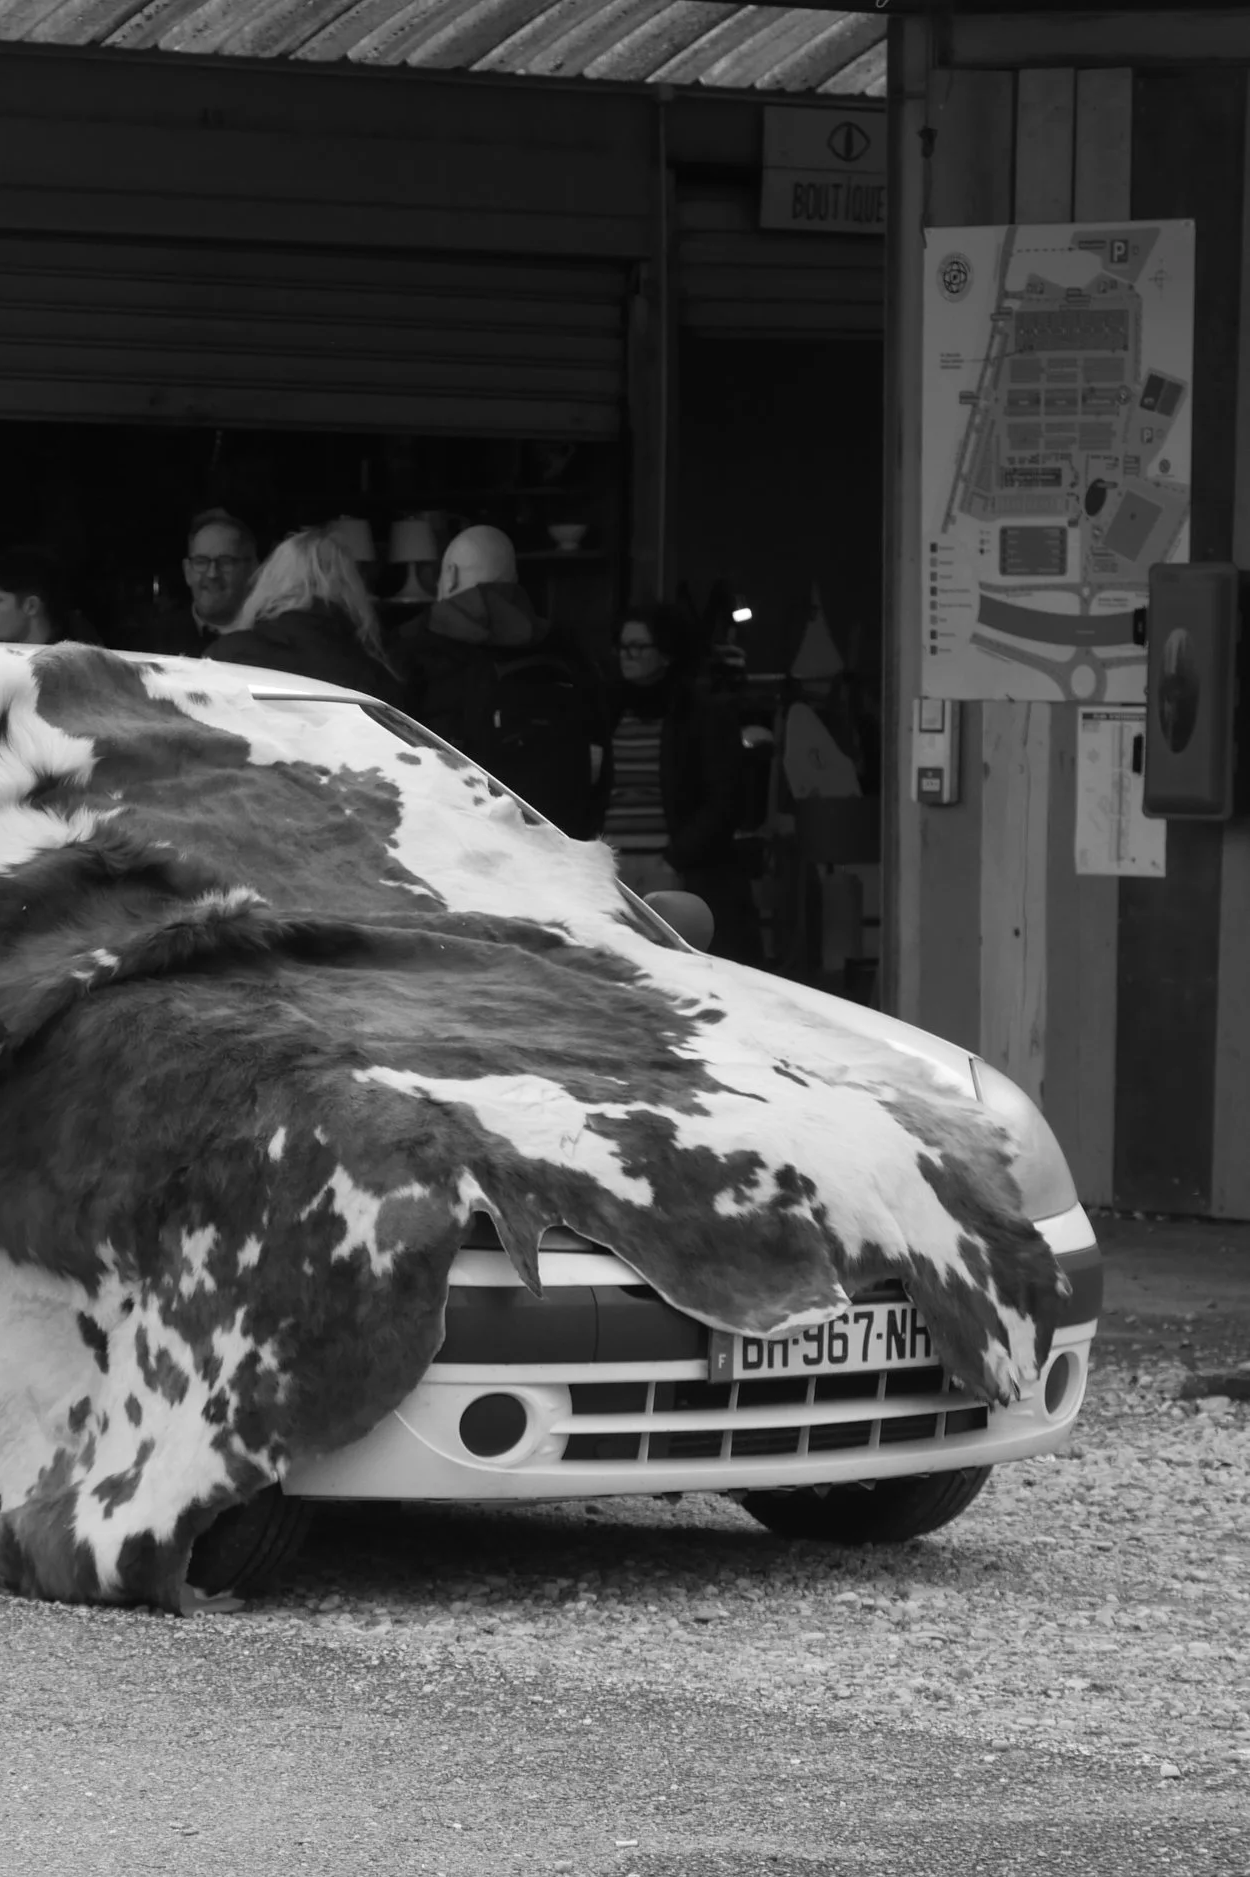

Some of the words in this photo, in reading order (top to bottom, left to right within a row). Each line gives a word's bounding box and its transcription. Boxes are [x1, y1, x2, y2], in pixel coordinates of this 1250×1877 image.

[792, 177, 887, 224] BOUTIQUE
[1113, 241, 1126, 262] P
[717, 1354, 726, 1369] F
